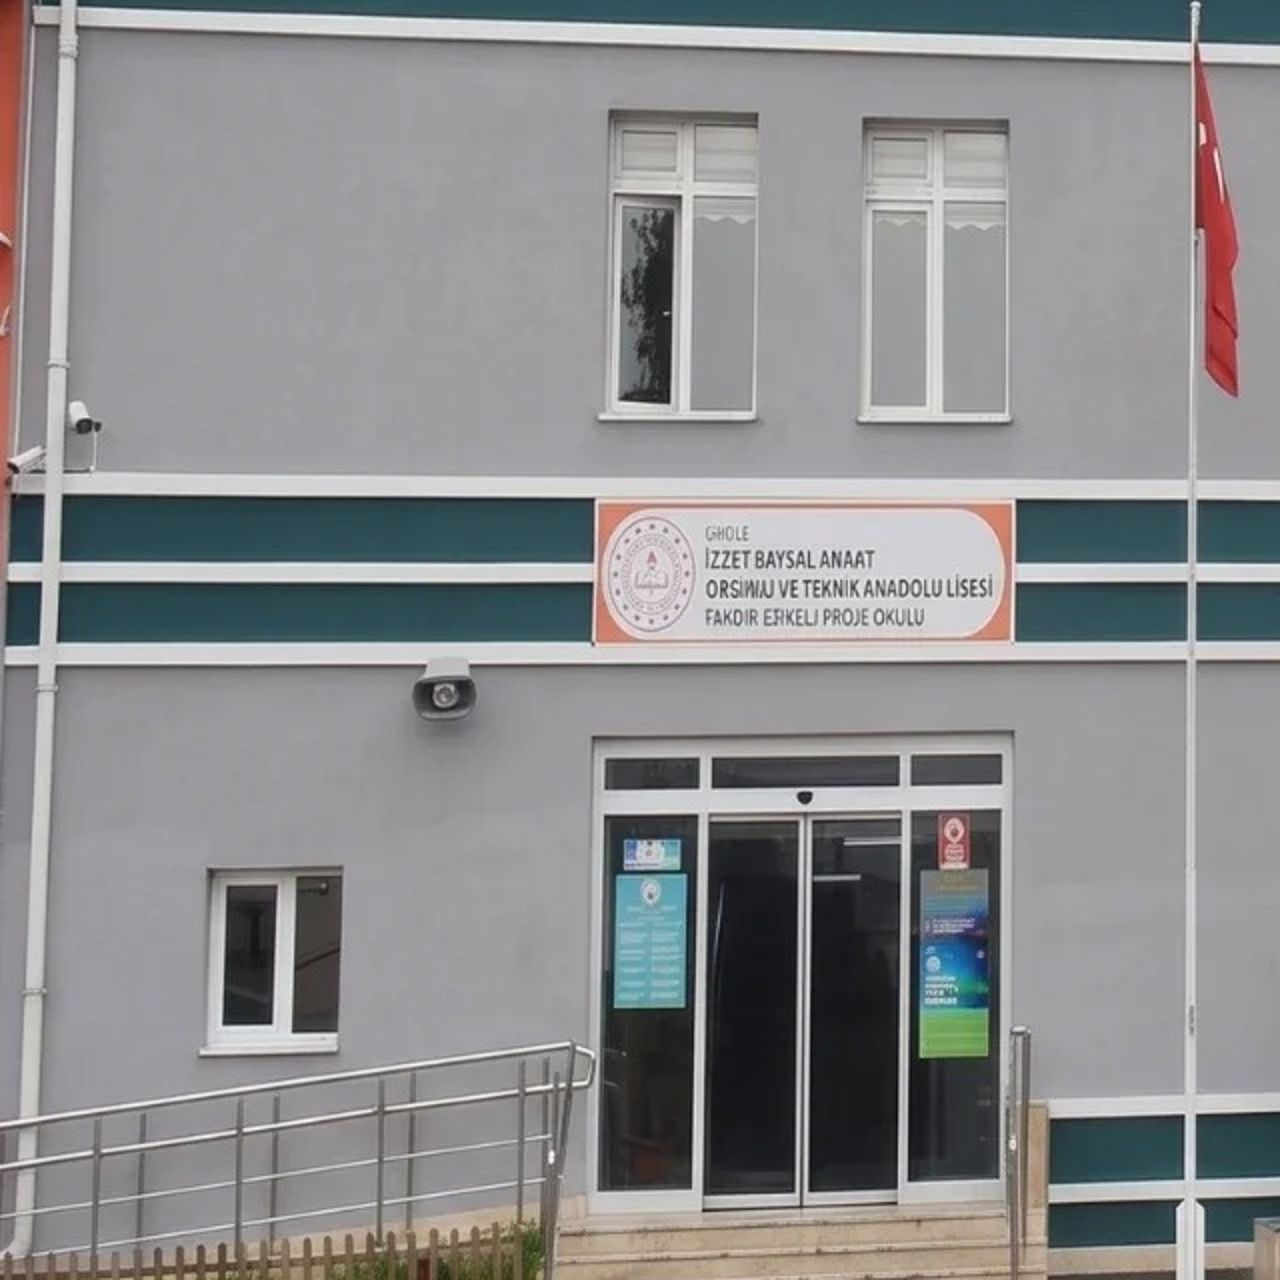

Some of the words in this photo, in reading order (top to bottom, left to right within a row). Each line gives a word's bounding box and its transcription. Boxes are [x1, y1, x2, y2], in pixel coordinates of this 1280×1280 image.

[705, 547, 751, 569] İZZET
[755, 549, 816, 569] BAYSAL
[779, 579, 799, 599] VE
[863, 578, 943, 598] ANADOLU
[947, 573, 993, 598] LİSESİ
[823, 607, 869, 627] PROJE
[873, 607, 925, 627] OKULU
